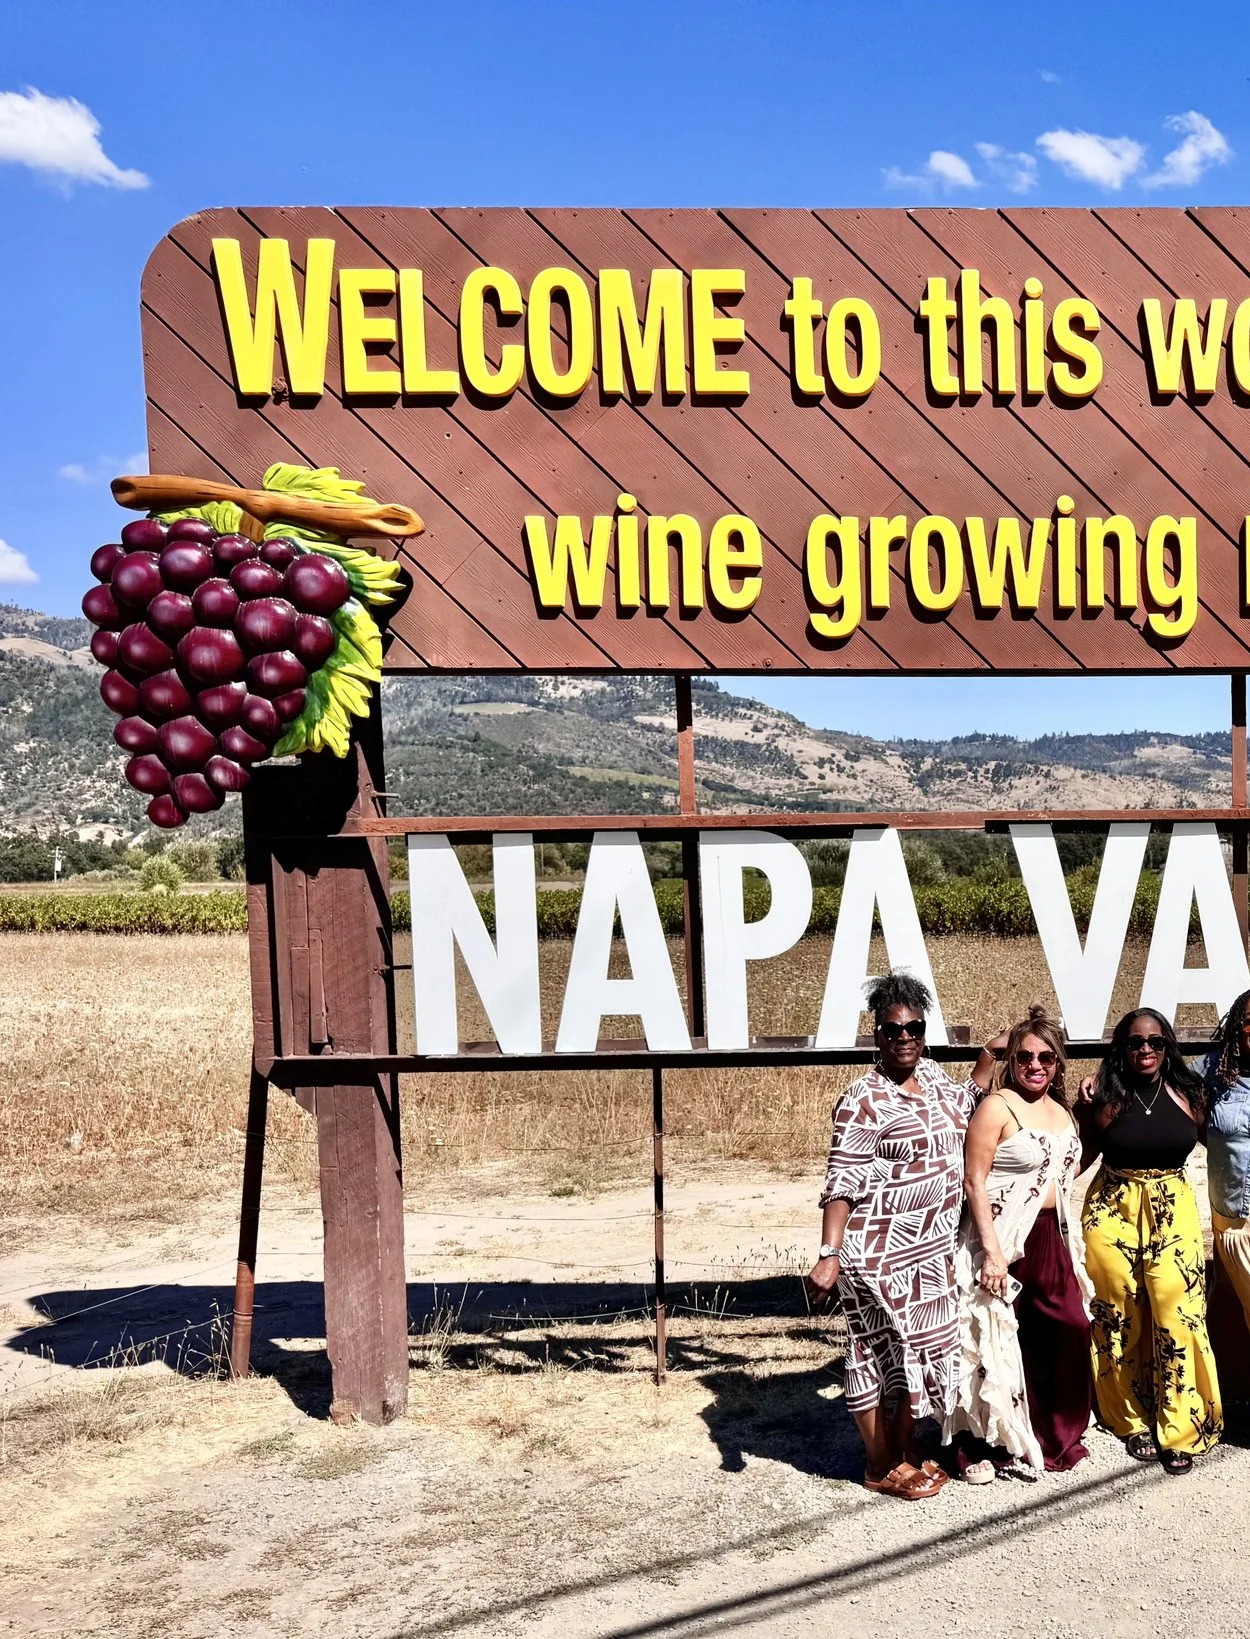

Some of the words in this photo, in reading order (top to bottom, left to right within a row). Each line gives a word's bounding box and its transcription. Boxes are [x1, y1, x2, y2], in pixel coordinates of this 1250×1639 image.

[212, 237, 751, 397] WELCOME
[785, 276, 882, 397] to
[920, 267, 1103, 399] this
[524, 494, 764, 611] wine
[805, 494, 1198, 640] growing
[407, 828, 948, 1056] NAPA
